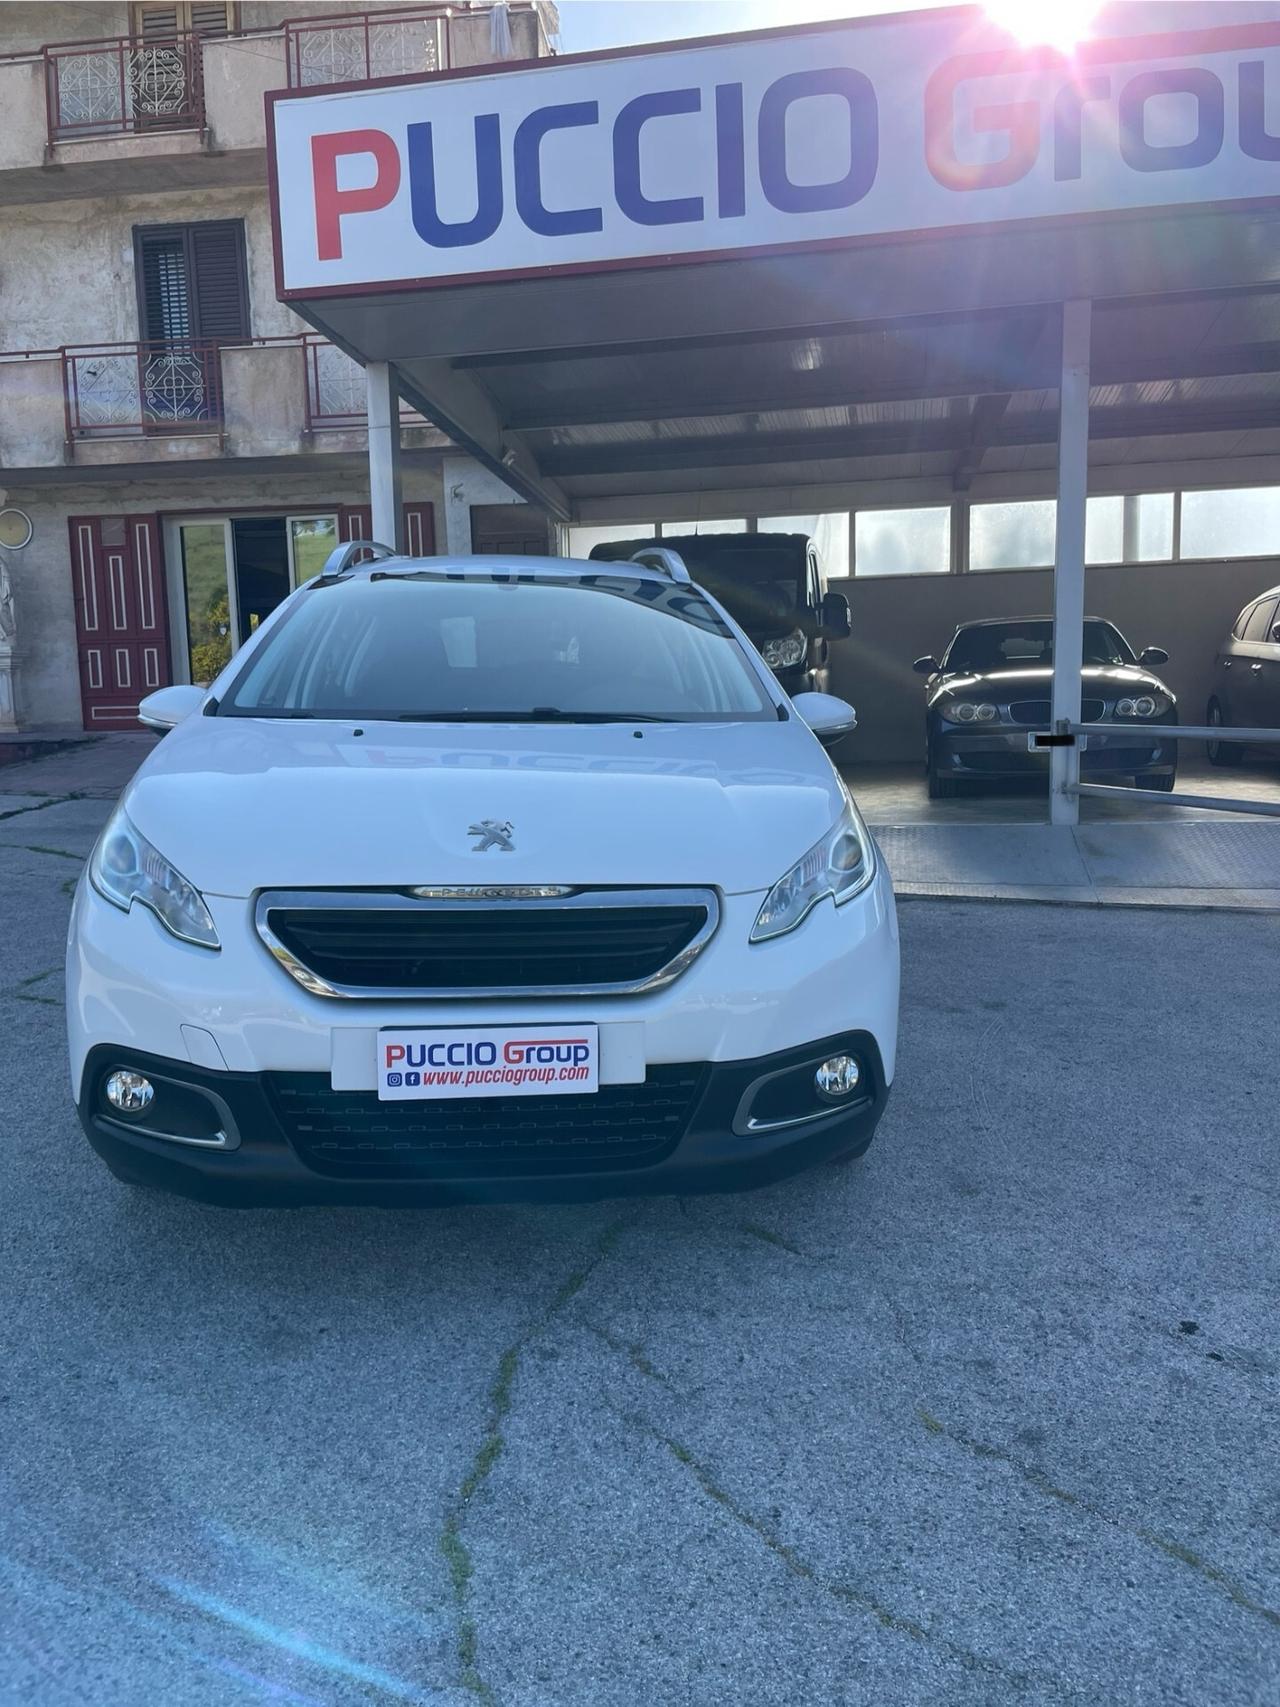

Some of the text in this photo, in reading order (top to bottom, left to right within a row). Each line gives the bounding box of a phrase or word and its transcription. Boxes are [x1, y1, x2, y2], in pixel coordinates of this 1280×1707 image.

[311, 67, 879, 261] PUCCIO
[385, 1039, 590, 1068] PUCCIO Group
[423, 1066, 589, 1087] www.pucciogroup.com
